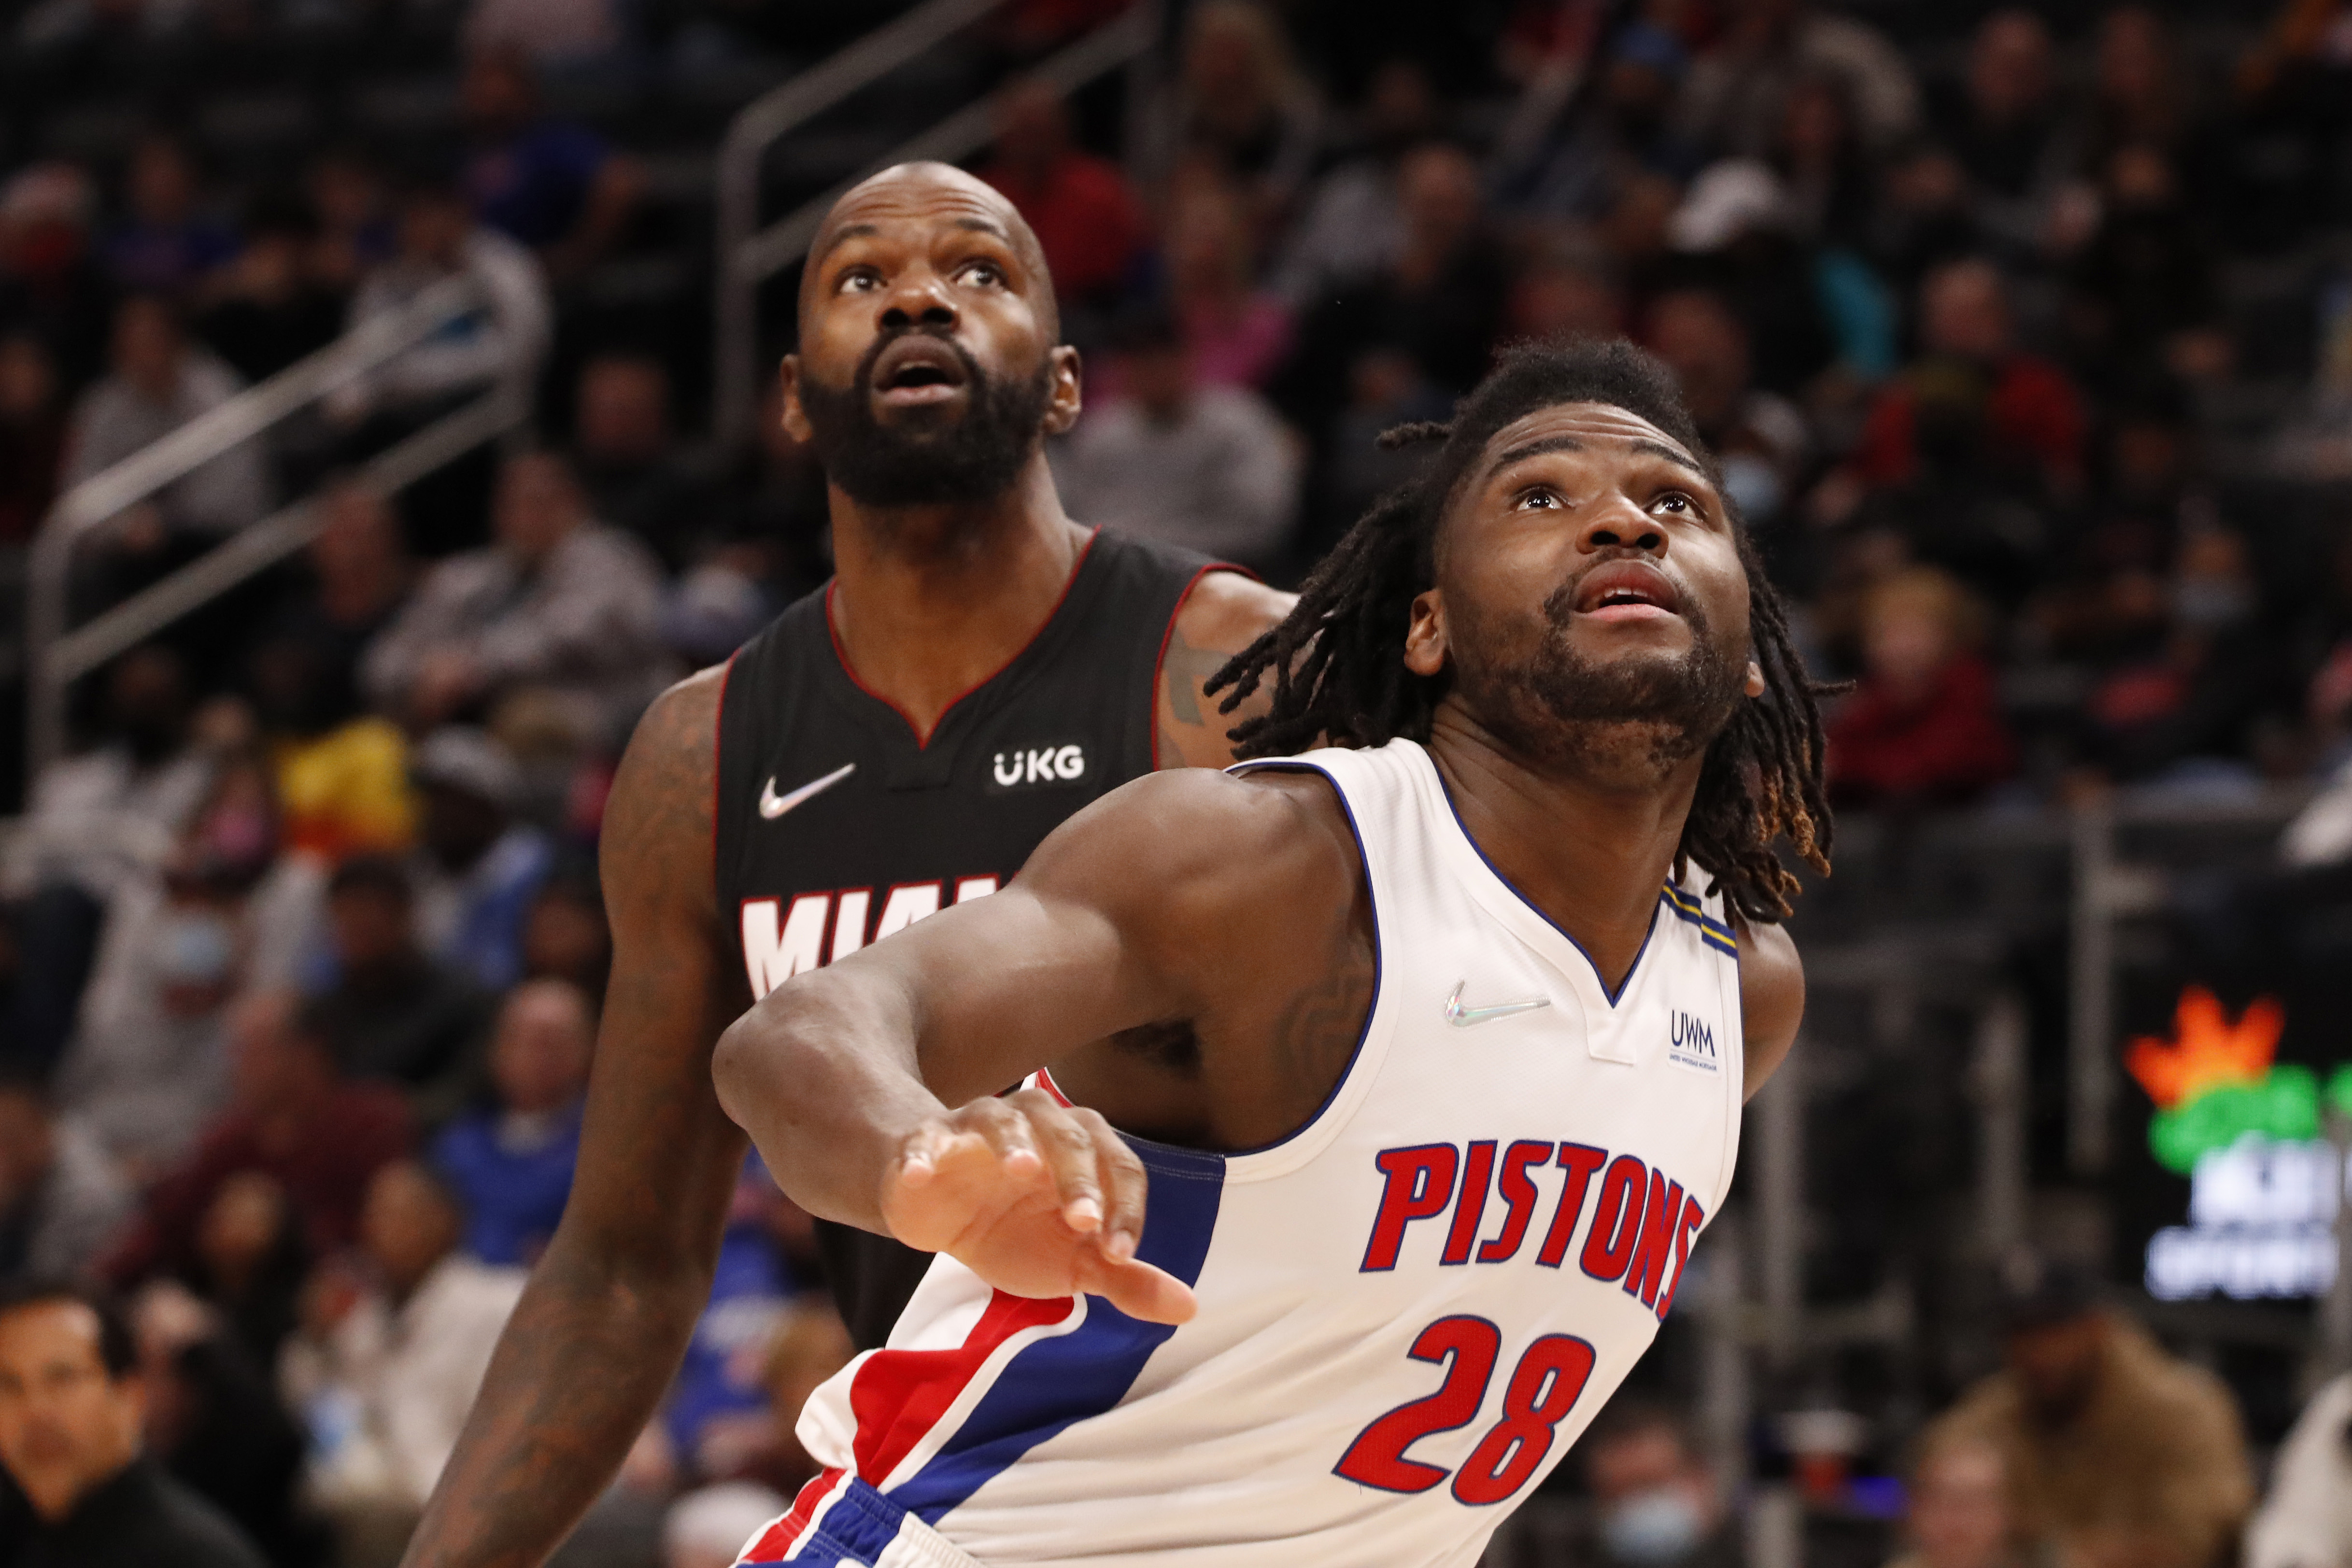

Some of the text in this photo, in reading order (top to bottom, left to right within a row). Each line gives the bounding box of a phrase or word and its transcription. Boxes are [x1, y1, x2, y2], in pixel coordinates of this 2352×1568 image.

[994, 744, 1085, 786] UKG
[1672, 1009, 1715, 1057] UWM
[1359, 1139, 1706, 1323] PISTONS
[1332, 1314, 1596, 1506] 28
